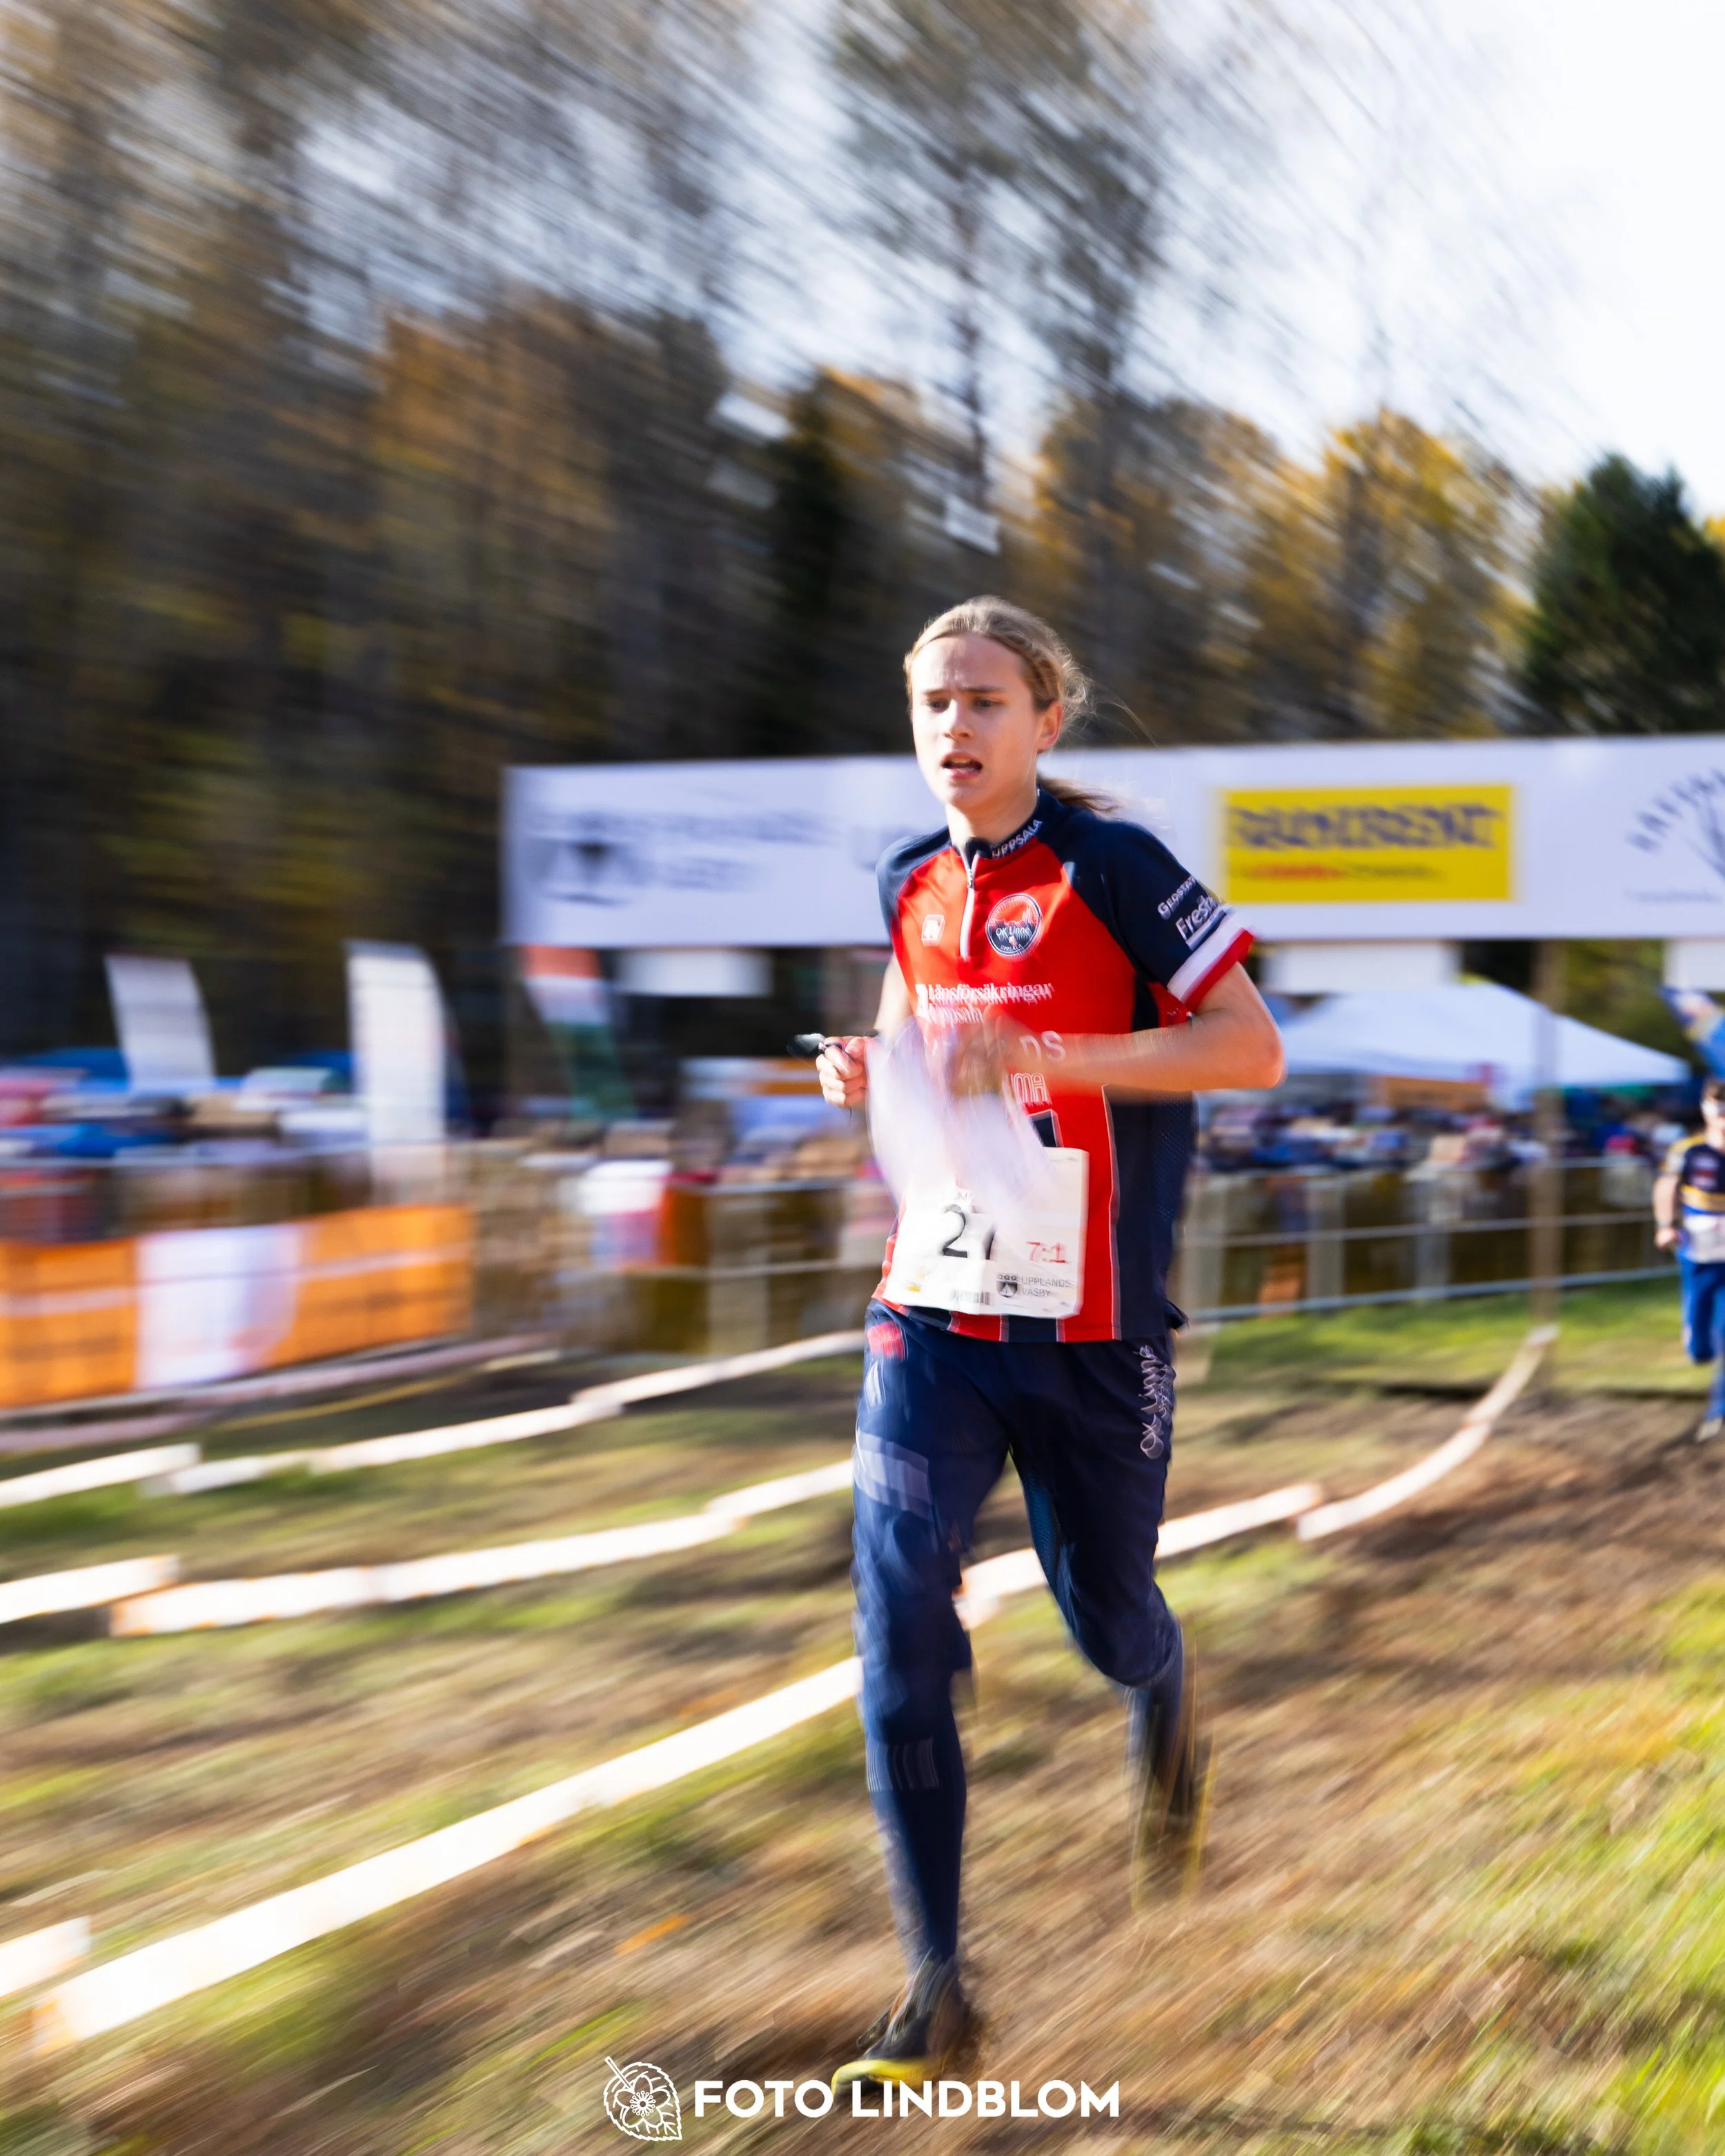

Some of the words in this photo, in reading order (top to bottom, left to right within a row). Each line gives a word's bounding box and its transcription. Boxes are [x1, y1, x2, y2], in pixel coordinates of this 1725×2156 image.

[992, 819, 1043, 859] UPPSALA
[996, 927, 1008, 937] OK
[1021, 1276, 1071, 1287] UPPLANDS
